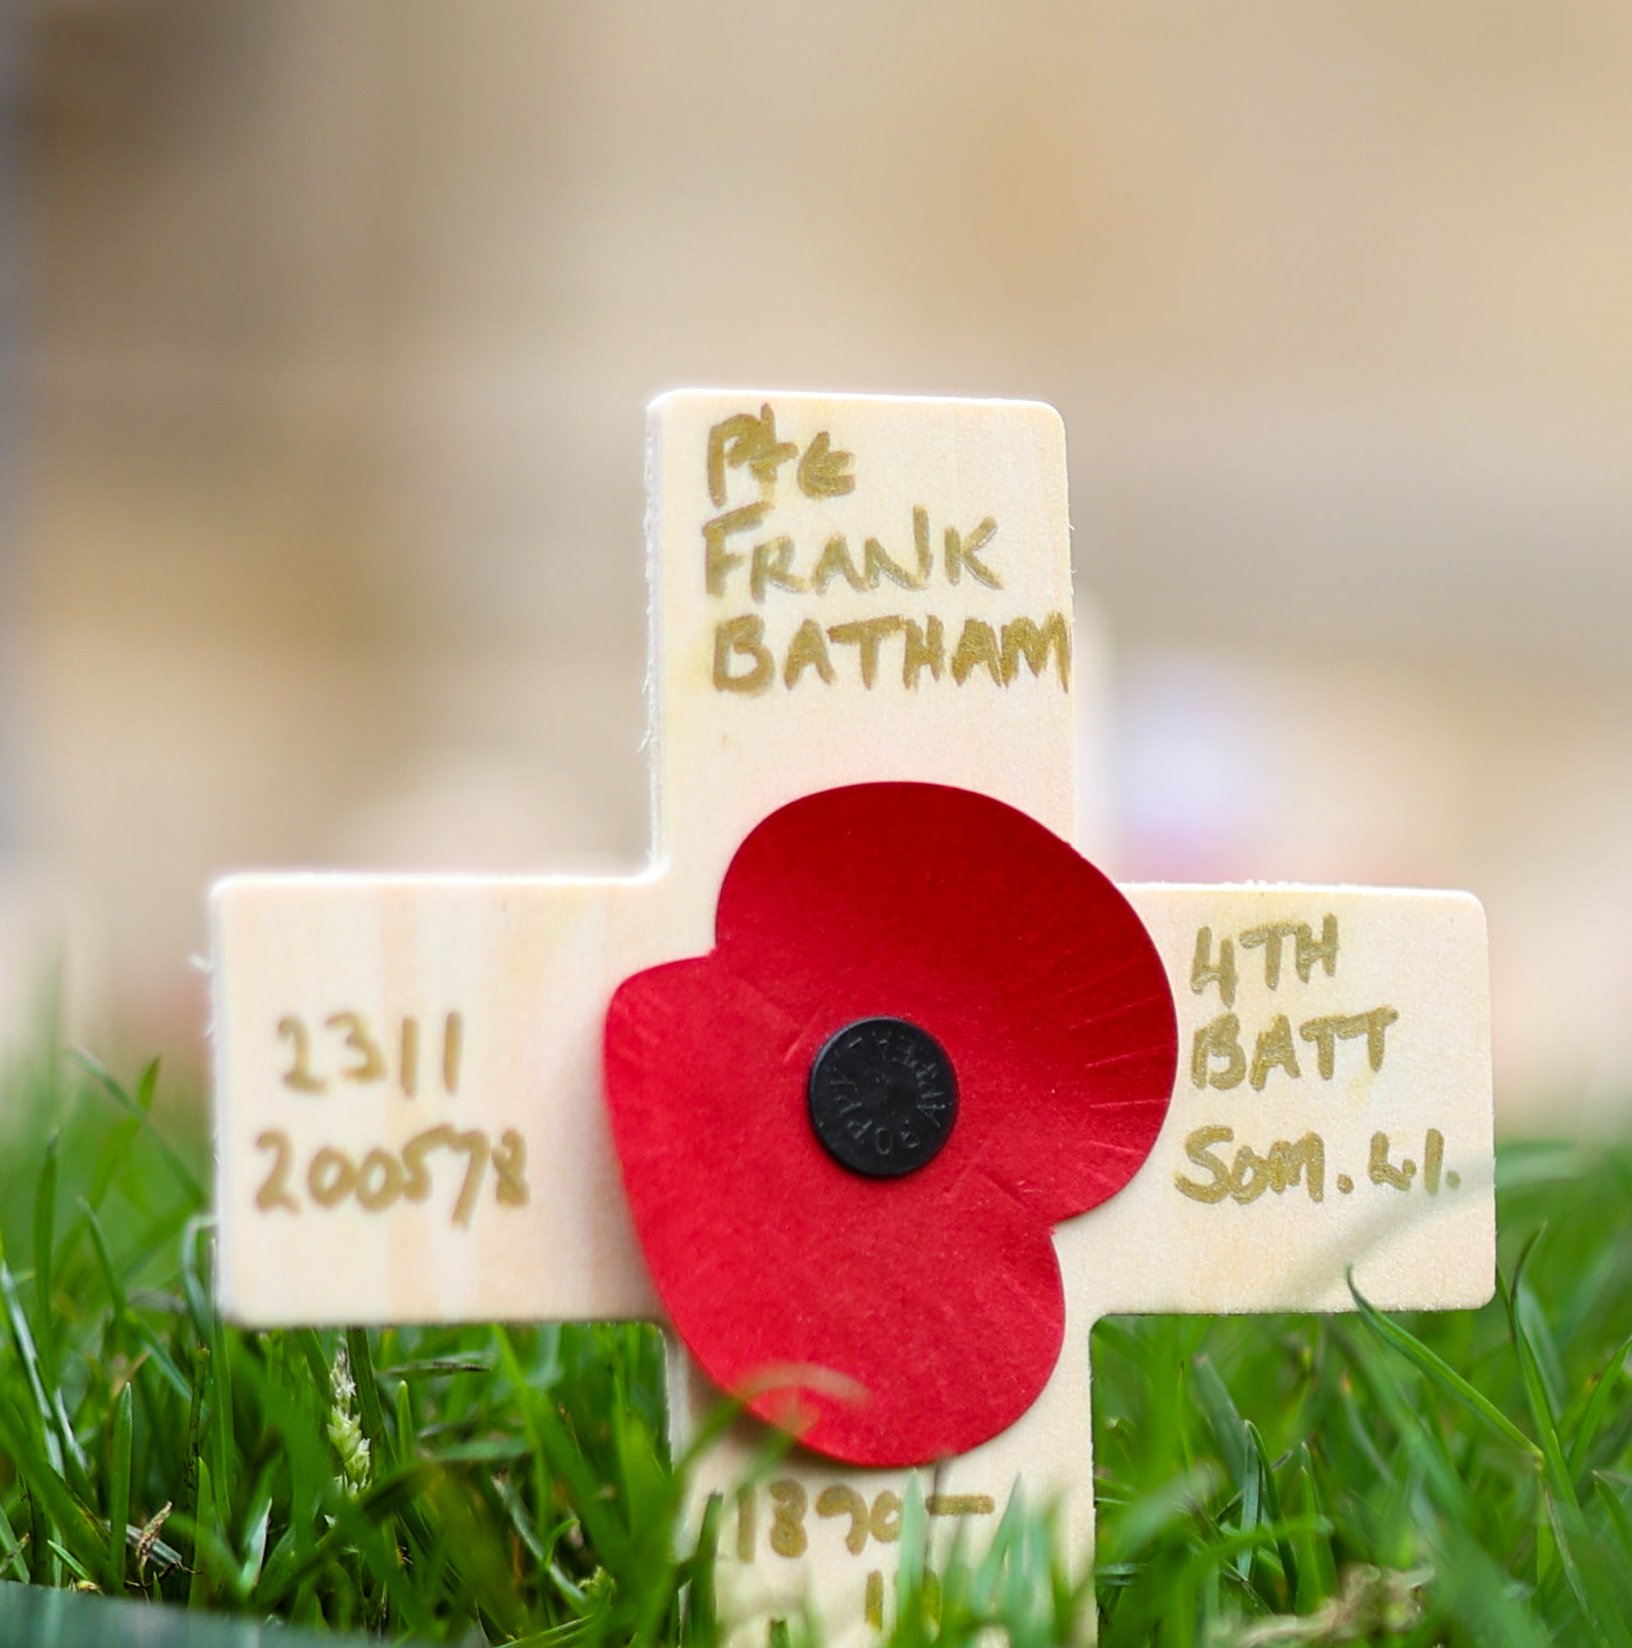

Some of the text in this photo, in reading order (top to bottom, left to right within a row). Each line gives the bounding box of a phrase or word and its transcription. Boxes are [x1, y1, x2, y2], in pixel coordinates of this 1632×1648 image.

[706, 402, 856, 507] Pte
[702, 499, 1004, 601] FRANK
[711, 612, 1070, 695] BATHAM
[1190, 912, 1340, 1009] 4TH
[276, 1009, 464, 1098] 2311
[1190, 1004, 1399, 1091] BATT
[255, 1123, 530, 1230] 200578
